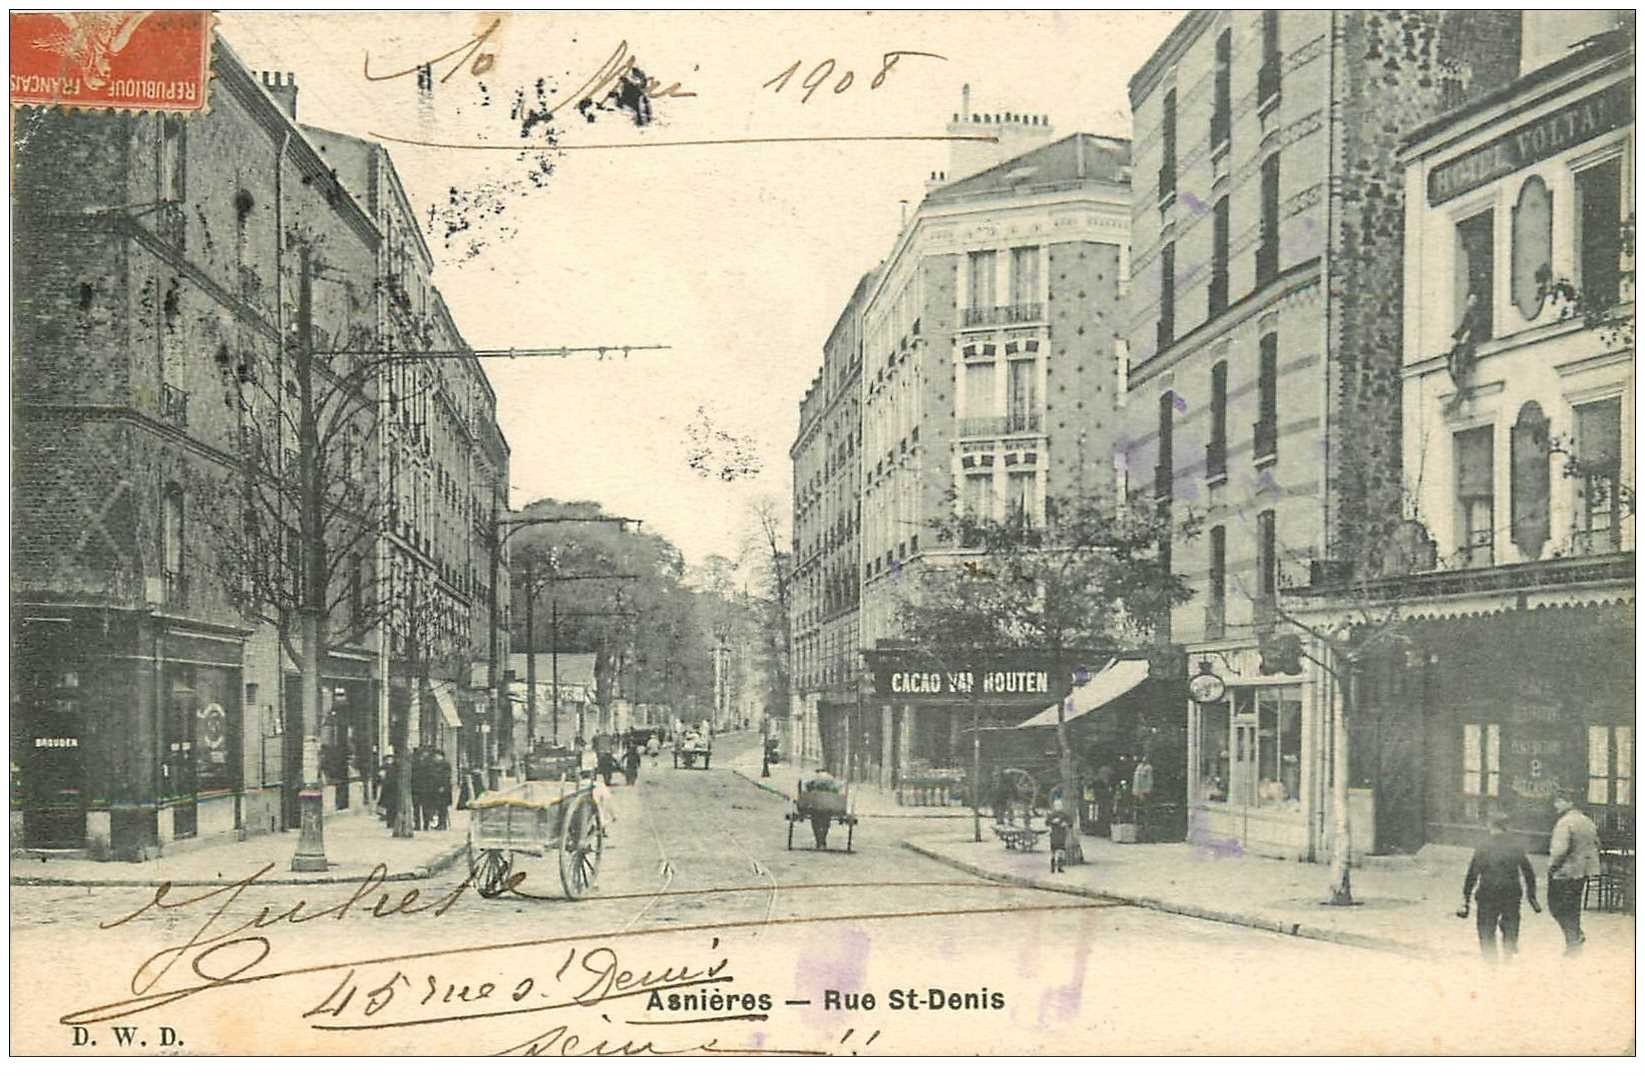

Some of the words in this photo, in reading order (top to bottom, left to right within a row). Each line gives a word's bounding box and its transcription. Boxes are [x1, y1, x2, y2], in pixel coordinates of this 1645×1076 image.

[762, 50, 948, 105] 1908
[891, 672, 941, 693] CACAO
[983, 671, 1048, 693] HOUTEN
[302, 969, 409, 1018] 45
[421, 974, 494, 1006] rue
[574, 937, 729, 1007] Denis
